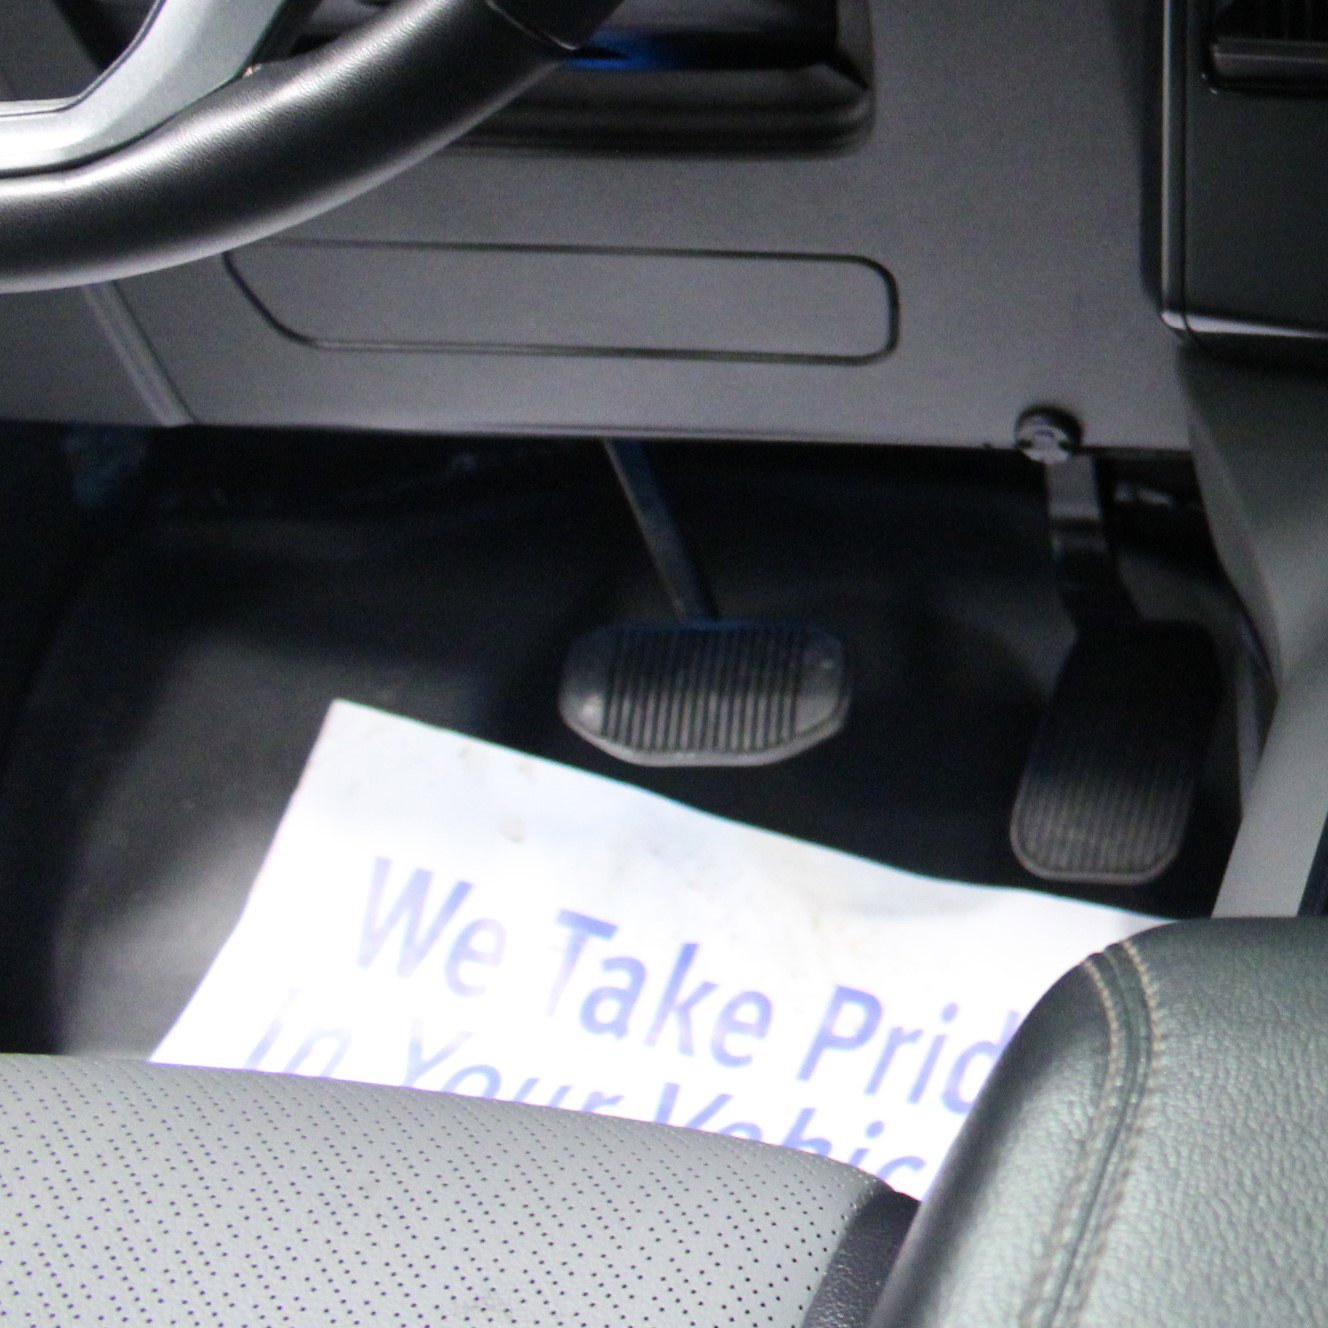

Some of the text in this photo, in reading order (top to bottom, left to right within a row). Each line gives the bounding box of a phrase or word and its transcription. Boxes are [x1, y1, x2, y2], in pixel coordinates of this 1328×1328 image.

[357, 858, 1021, 1115] We Take Prid
